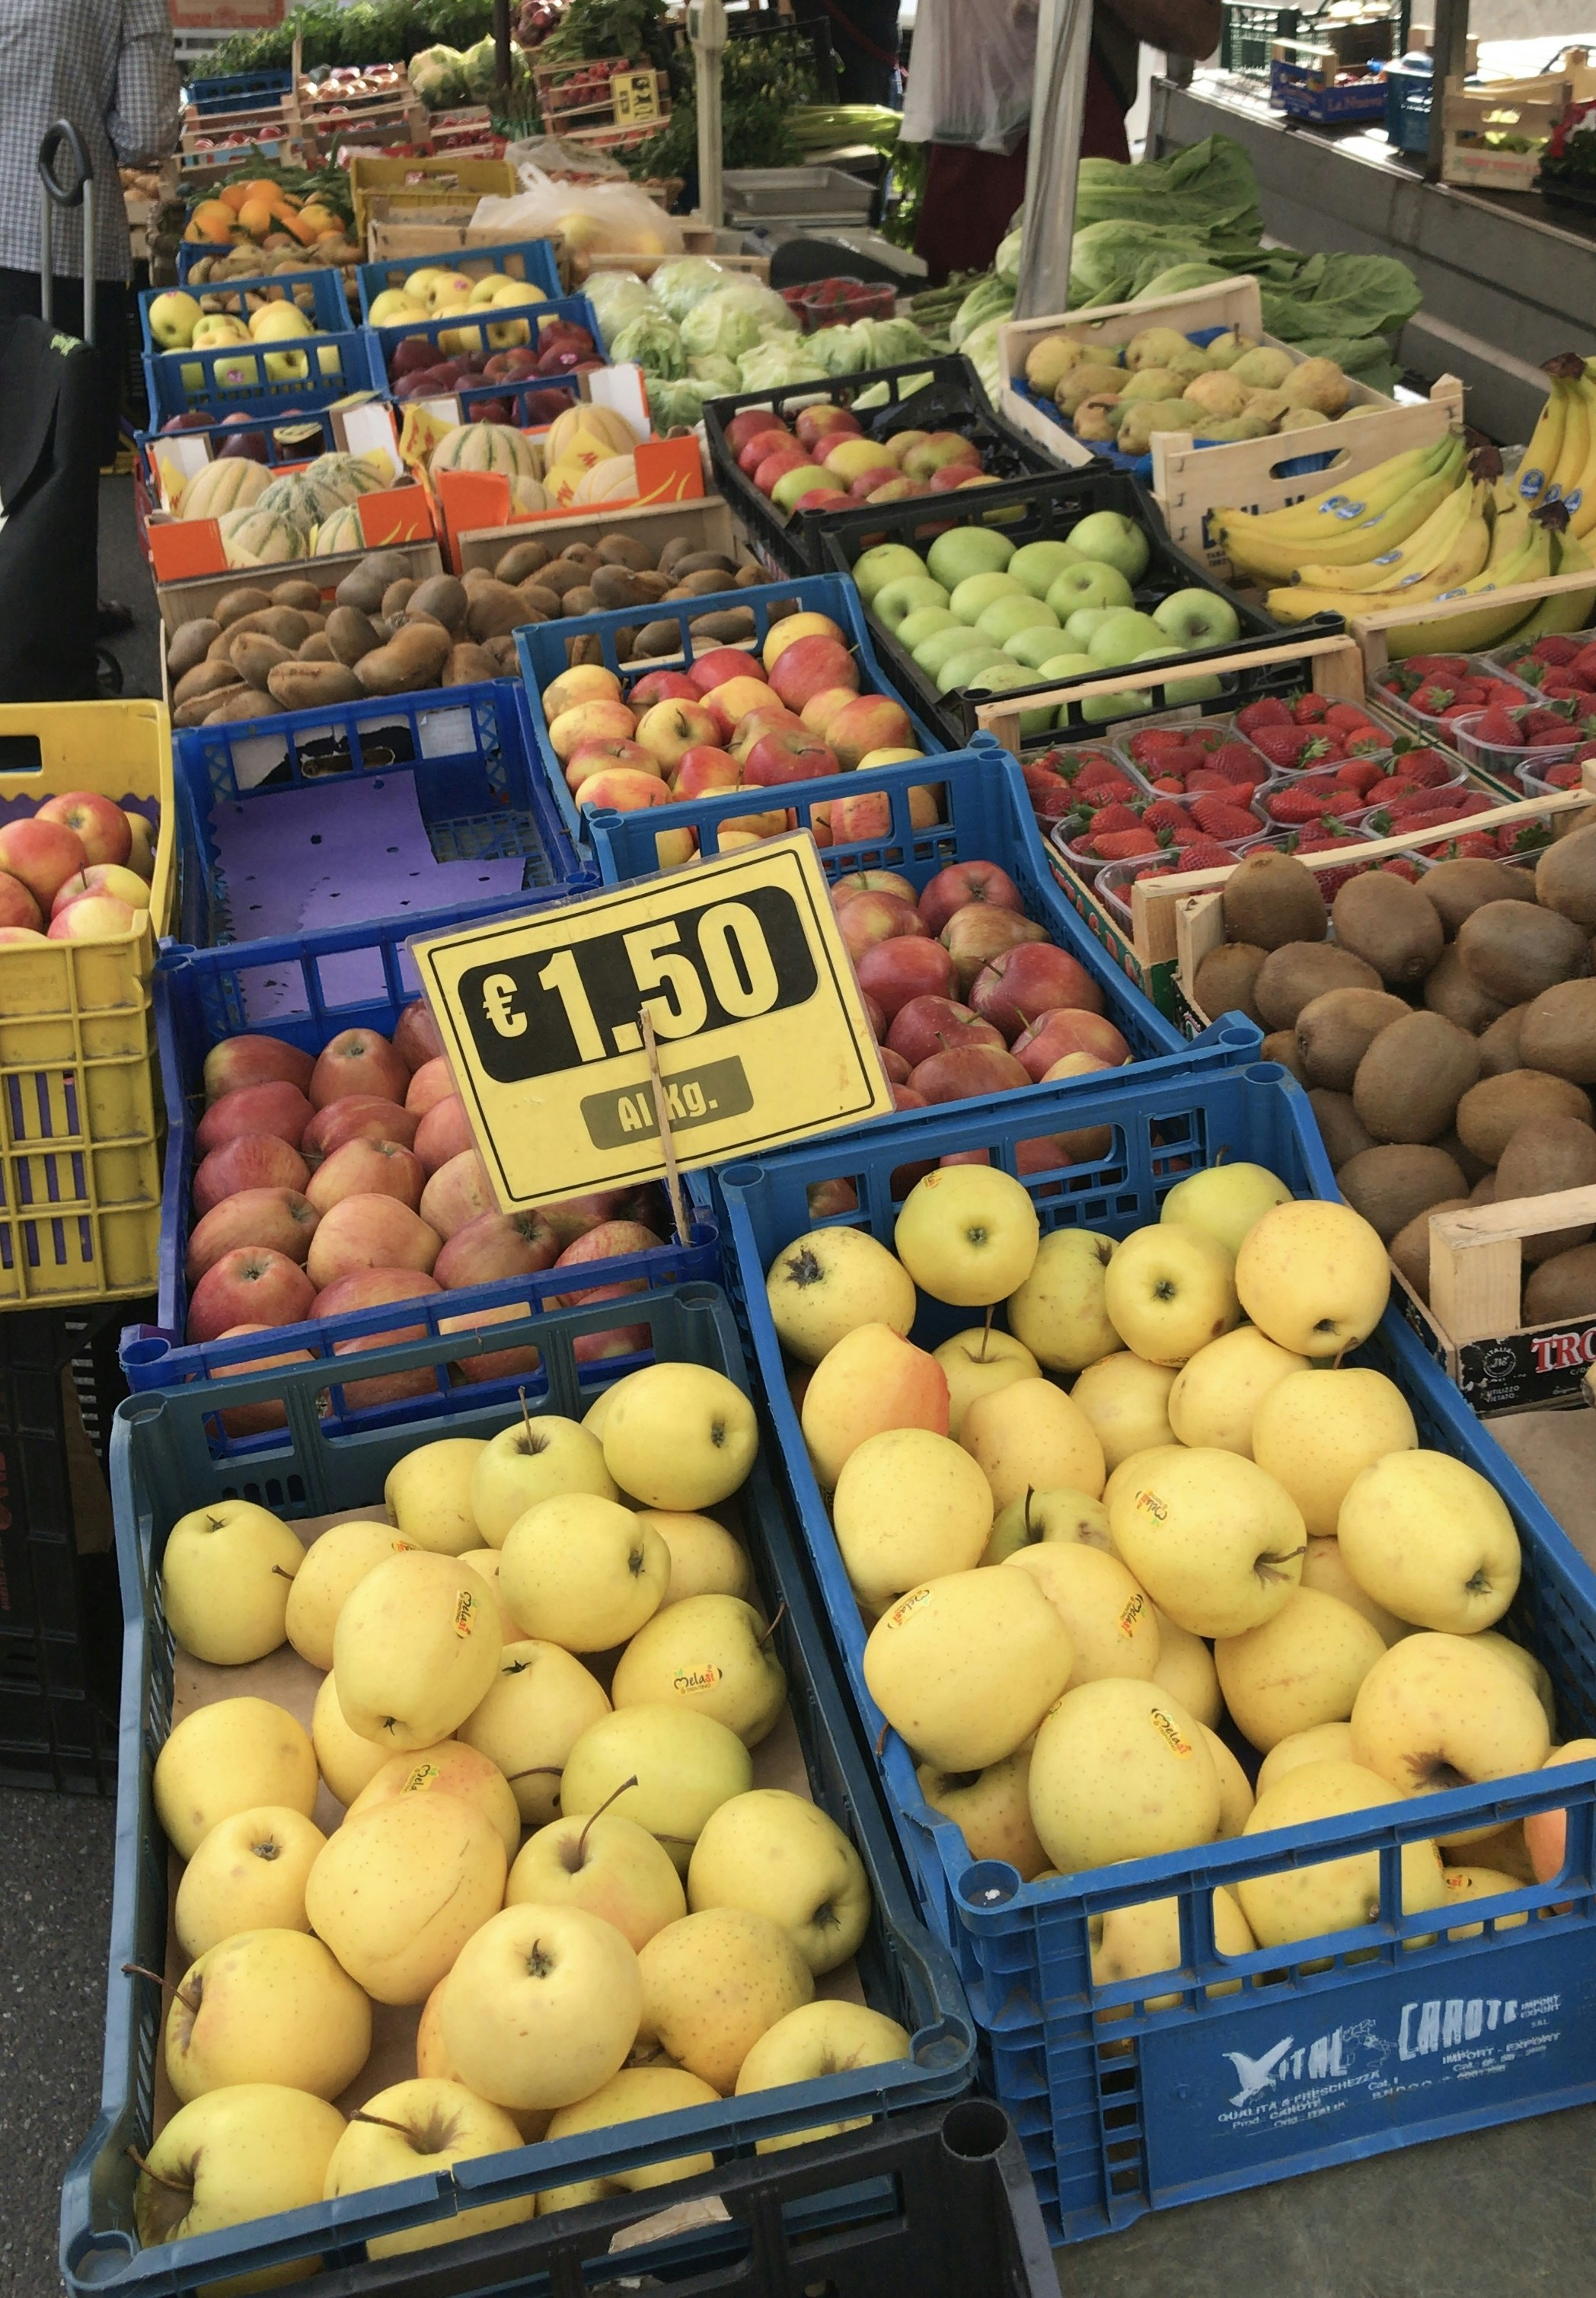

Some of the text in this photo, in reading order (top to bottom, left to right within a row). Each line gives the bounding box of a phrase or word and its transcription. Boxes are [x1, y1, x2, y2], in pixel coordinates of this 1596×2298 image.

[482, 902, 779, 1063] € 1.50
[617, 1080, 719, 1133] Al Kg.
